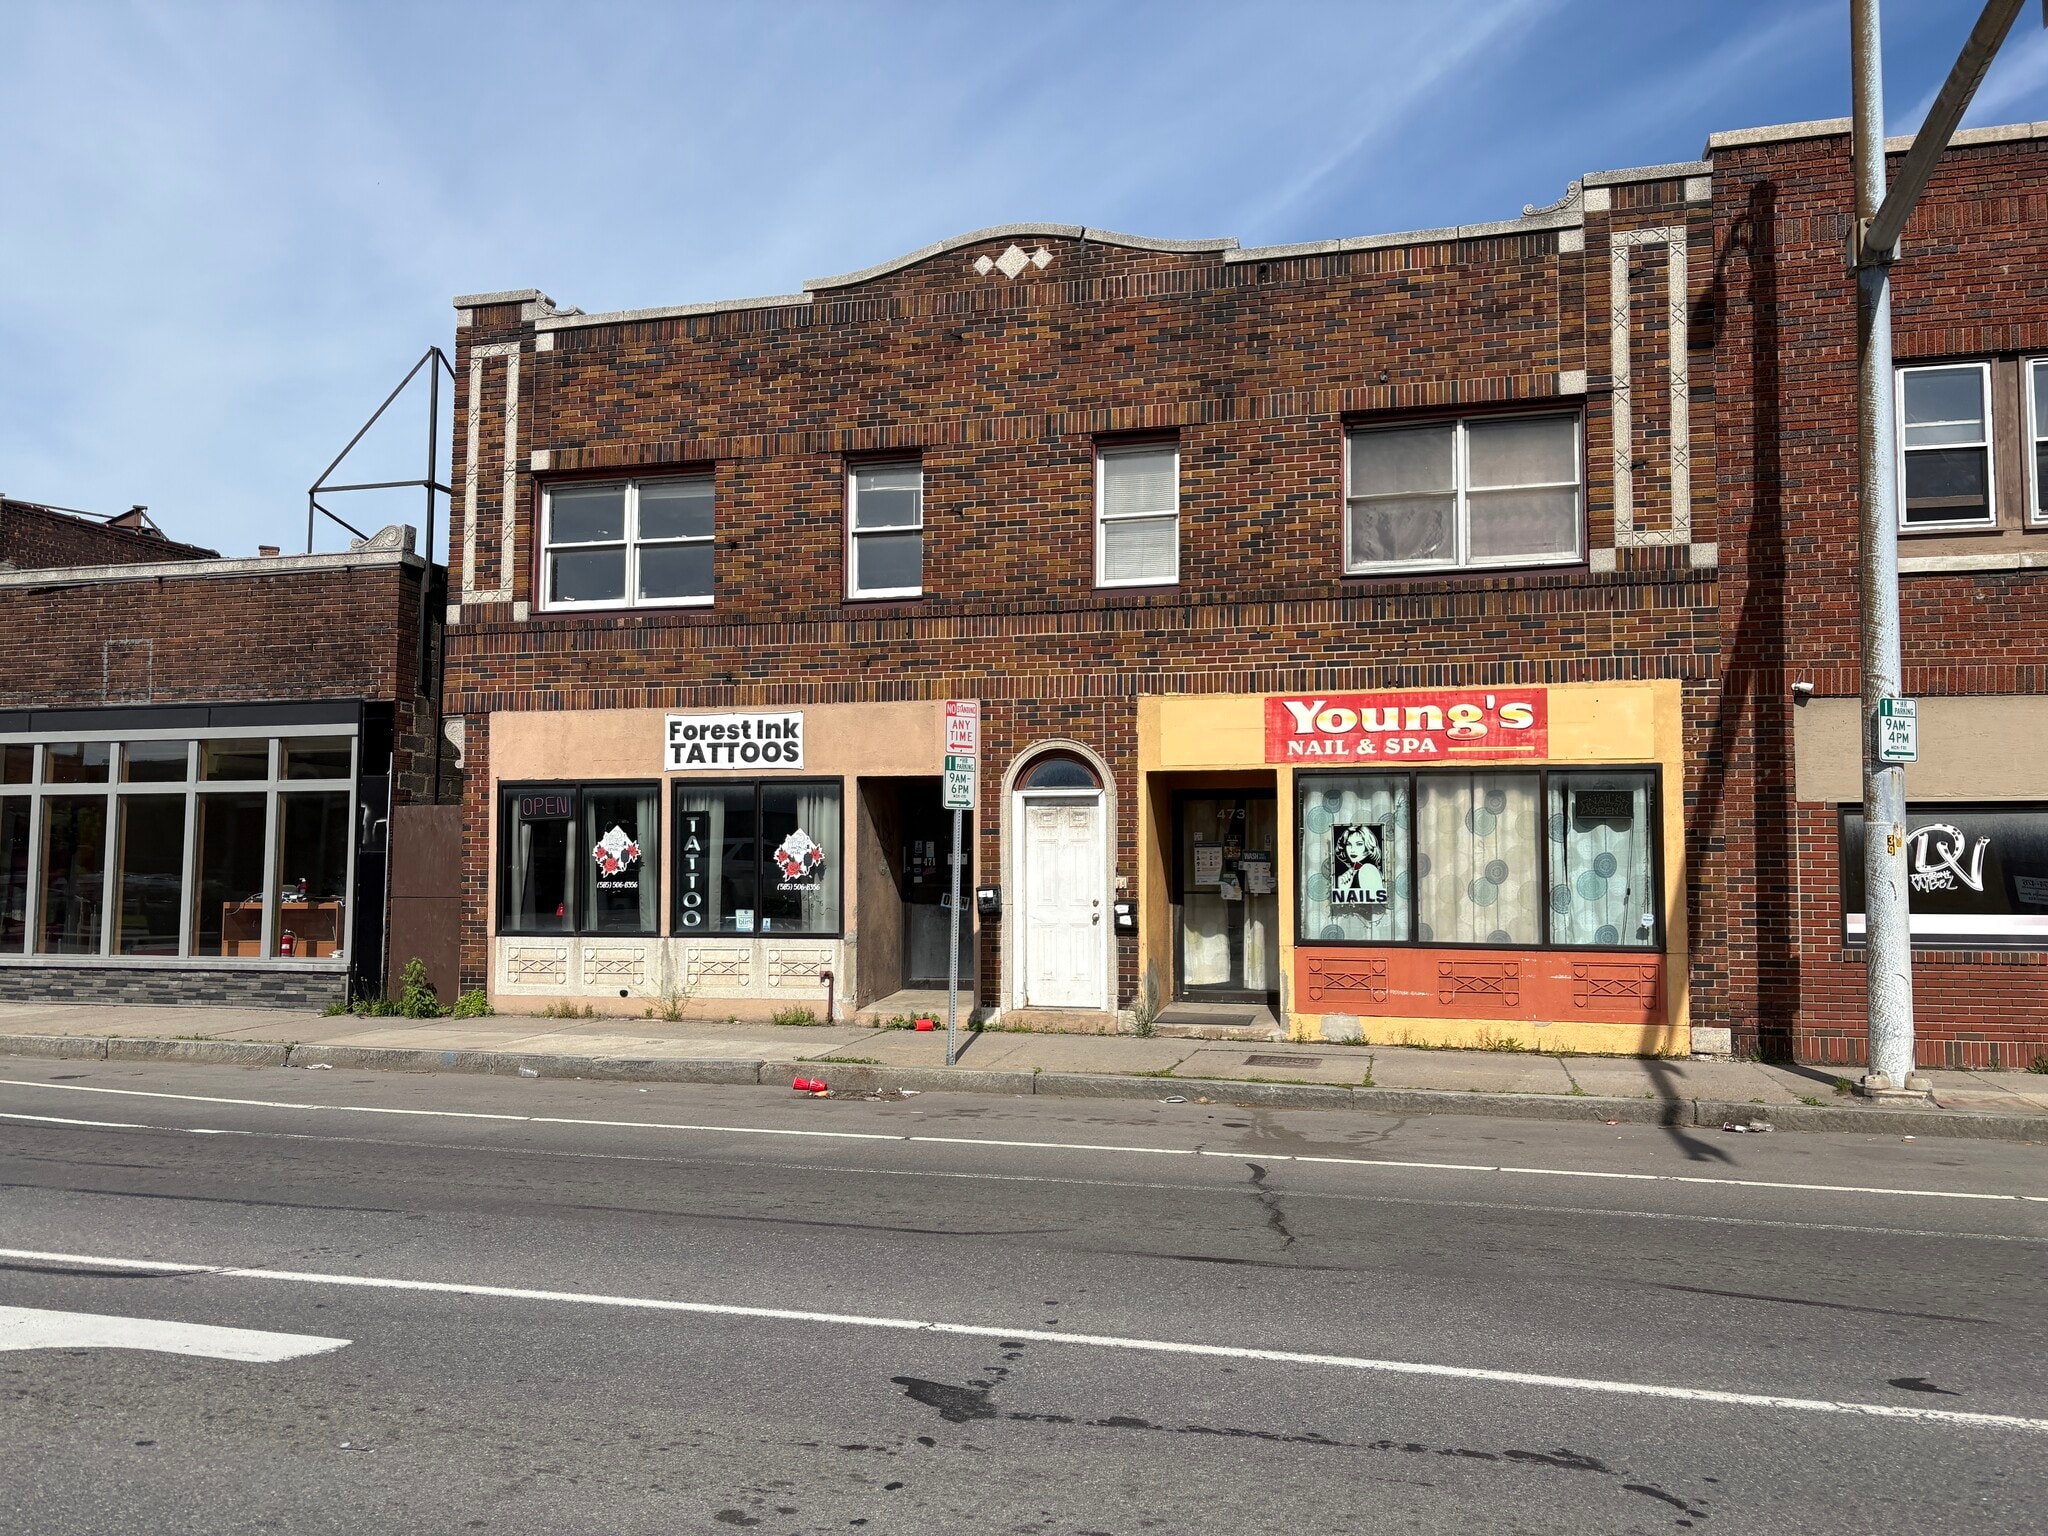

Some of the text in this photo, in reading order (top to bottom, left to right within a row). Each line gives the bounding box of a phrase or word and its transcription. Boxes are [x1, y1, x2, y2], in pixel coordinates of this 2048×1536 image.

[947, 702, 976, 715] NO STANDING
[1894, 707, 1914, 715] PARKING
[1283, 695, 1534, 741] Young's
[669, 718, 800, 740] Forest Ink
[952, 720, 971, 730] ANY
[950, 731, 973, 742] TIME
[670, 741, 799, 763] TATTOOS
[1287, 737, 1438, 756] NAIL & SPA
[522, 796, 567, 816] OPEN
[1589, 794, 1625, 806] NAILS
[1216, 808, 1246, 819] 473
[1590, 807, 1619, 815] OPEN
[923, 857, 936, 866] 471
[1243, 852, 1259, 860] WASH
[682, 816, 701, 927] TATTOO
[776, 883, 793, 891] (585)
[1332, 890, 1388, 903] NAILS
